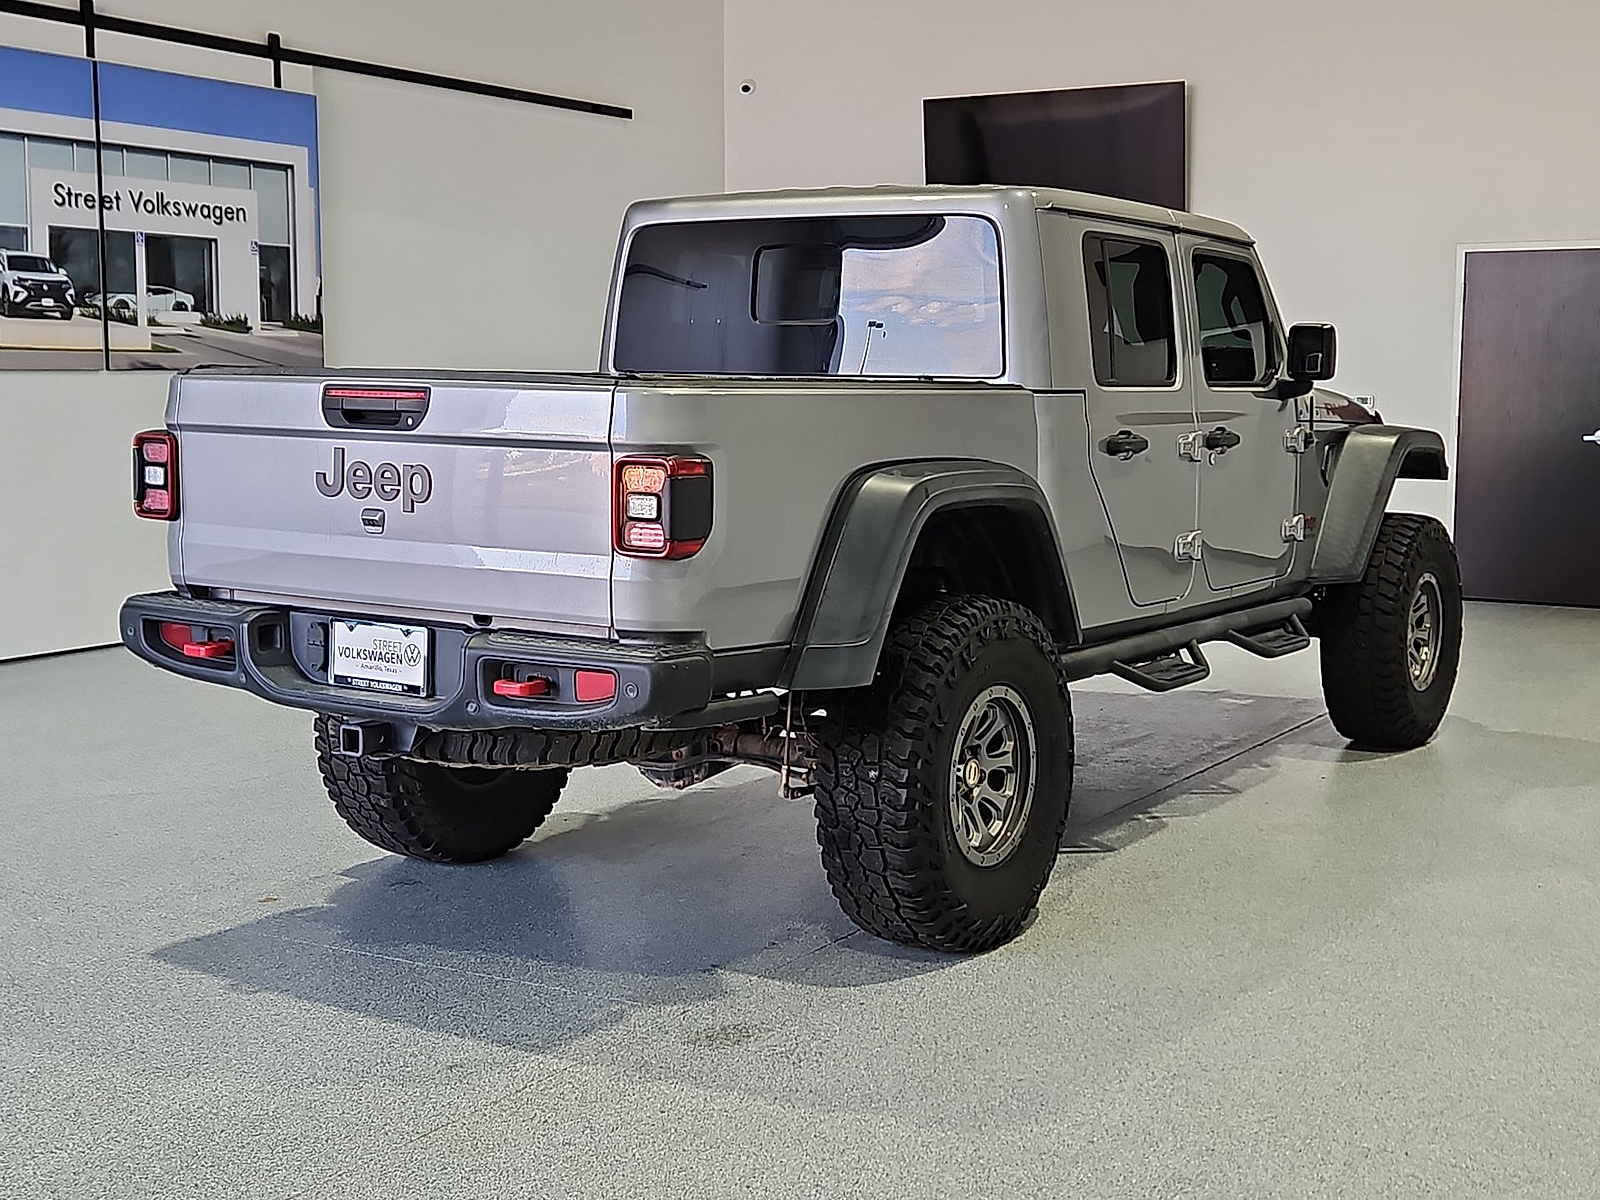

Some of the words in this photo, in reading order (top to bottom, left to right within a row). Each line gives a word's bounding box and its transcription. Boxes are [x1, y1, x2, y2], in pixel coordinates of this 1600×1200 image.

[52, 182, 122, 212] Street
[127, 189, 248, 226] Volkswagen
[315, 446, 433, 513] Jeep
[337, 645, 403, 665] VOLKSWAGEN
[372, 639, 403, 653] STREET
